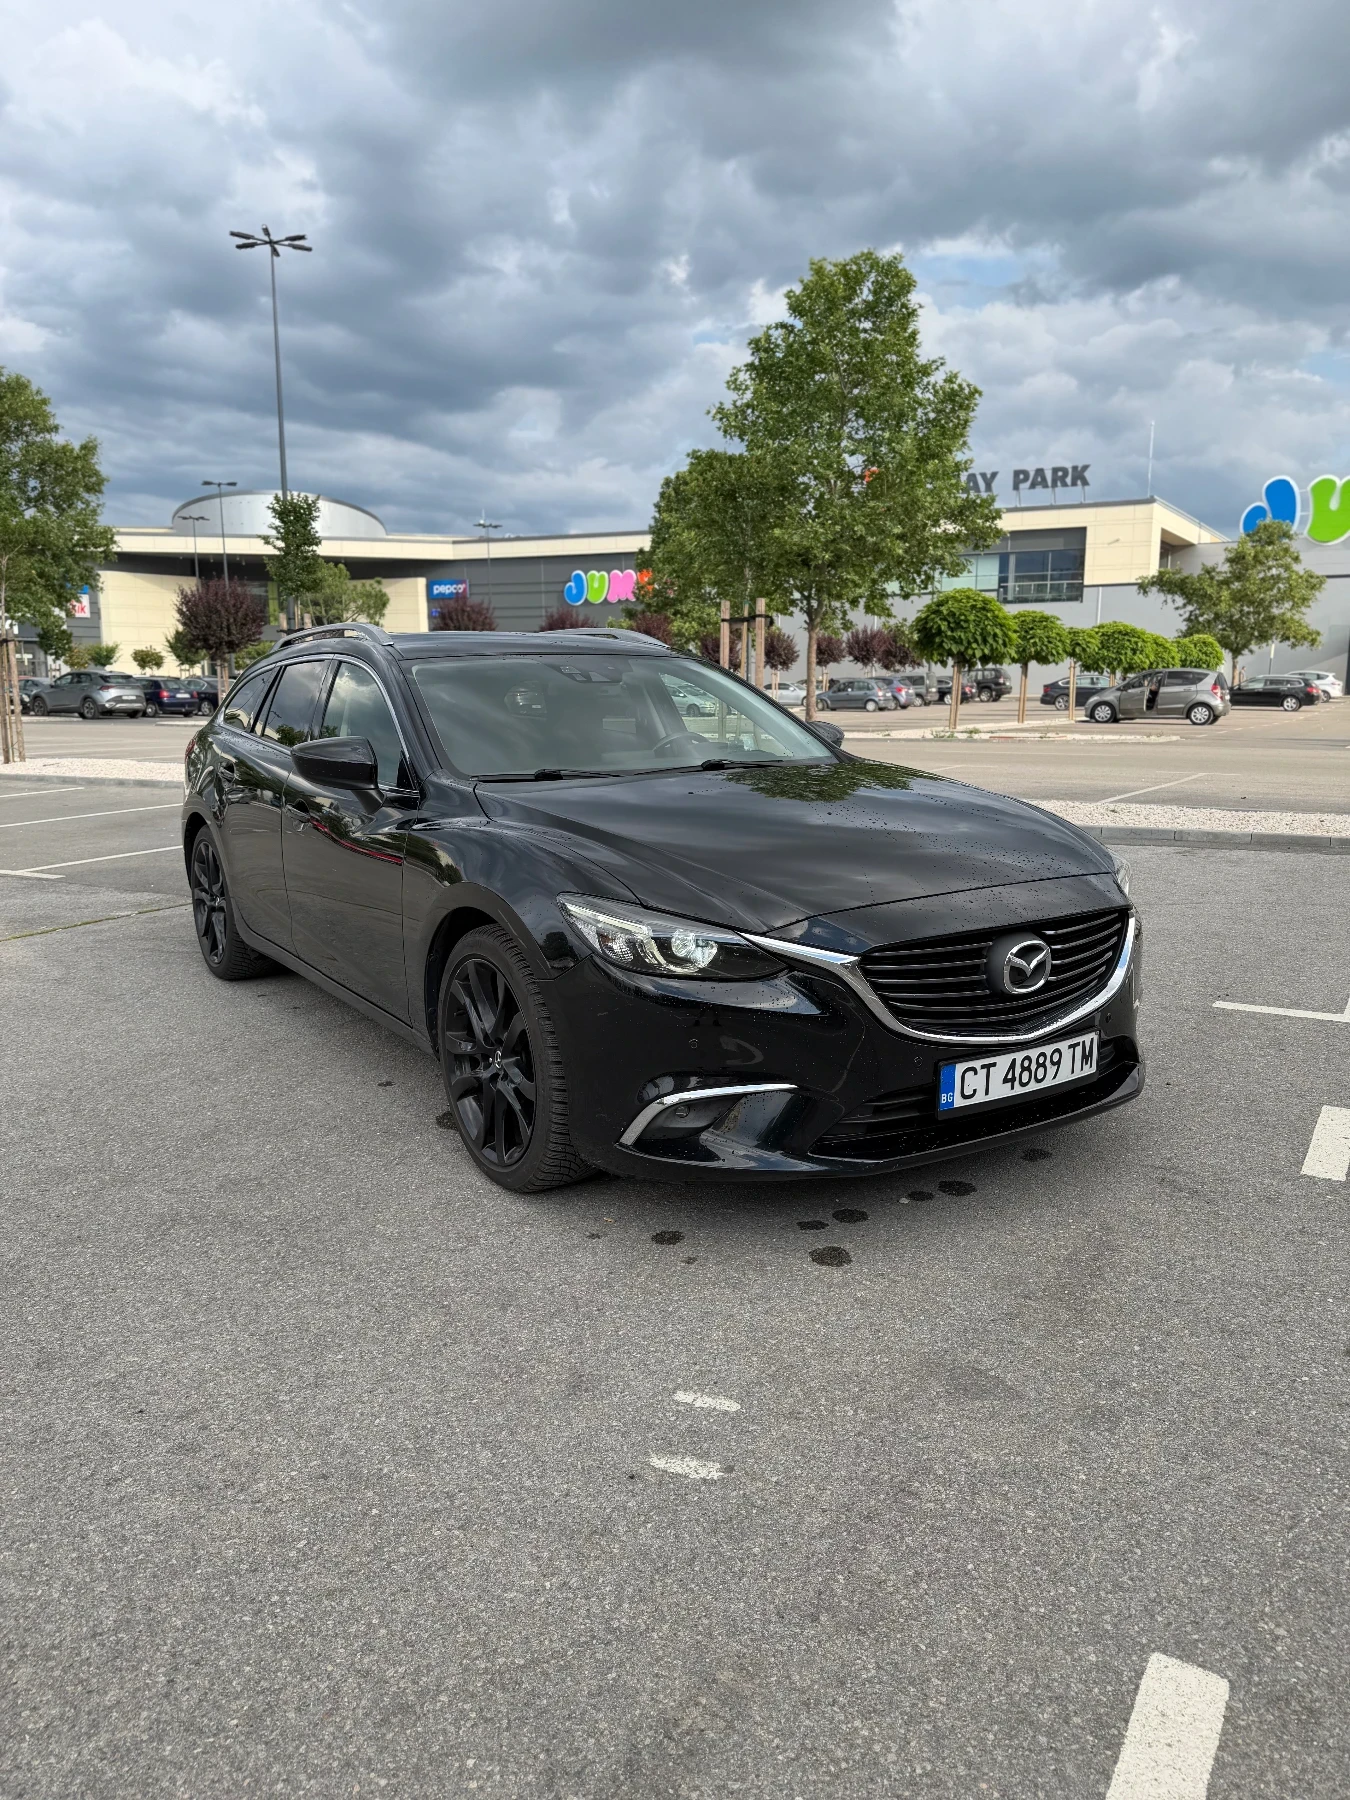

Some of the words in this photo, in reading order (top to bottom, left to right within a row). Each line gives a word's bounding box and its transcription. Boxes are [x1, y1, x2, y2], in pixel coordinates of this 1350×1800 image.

[961, 471, 999, 494] AY
[1012, 464, 1091, 491] PARK
[433, 583, 464, 596] pepco
[960, 1062, 997, 1100] CT
[1002, 1047, 1063, 1091] 4889
[1067, 1037, 1095, 1075] TM
[941, 1092, 953, 1103] BG
